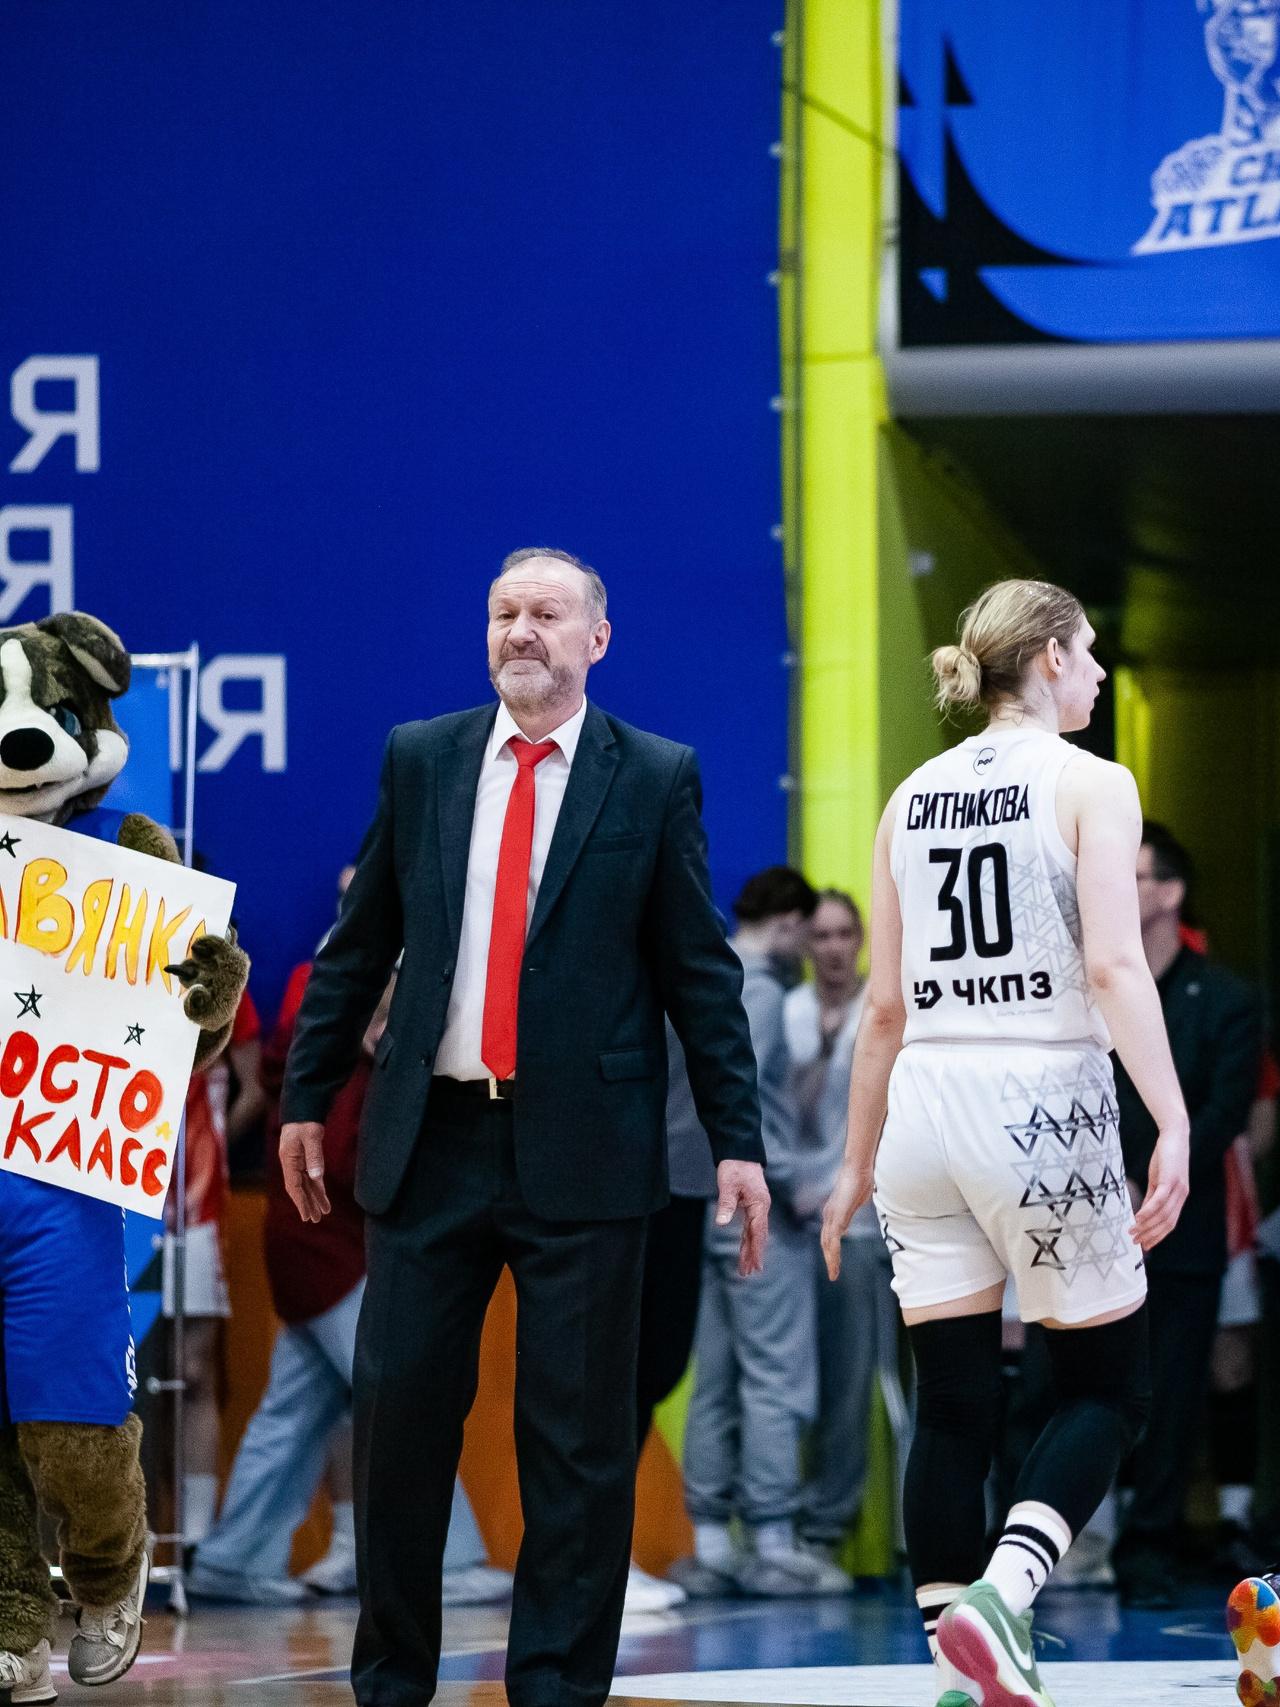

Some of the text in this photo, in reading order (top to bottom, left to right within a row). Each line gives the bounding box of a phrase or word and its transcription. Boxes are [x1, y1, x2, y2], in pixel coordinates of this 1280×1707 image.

[170, 653, 287, 772] Я
[907, 783, 1030, 831] СИТНИКОВА
[0, 857, 207, 997] ВЯНК
[929, 842, 1014, 962] 30
[953, 971, 1053, 1006] ЧКПЗ
[3, 1099, 169, 1197] КЛАСС
